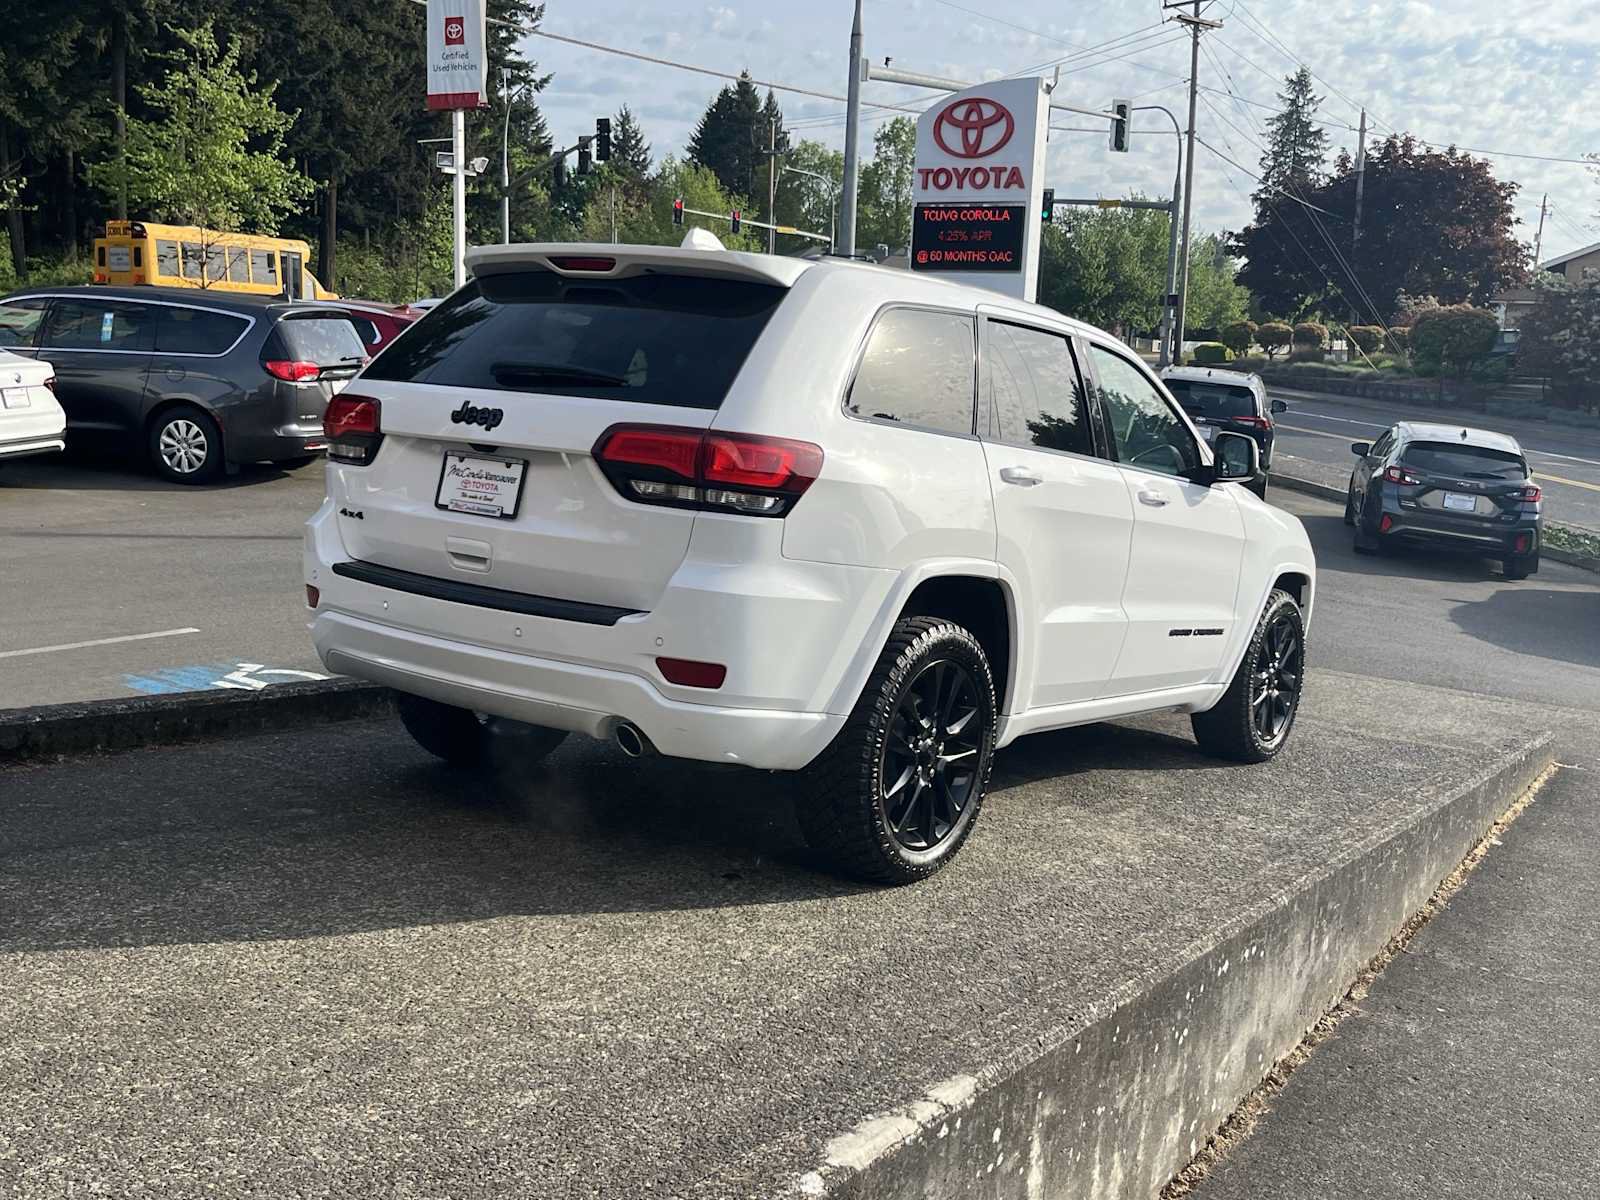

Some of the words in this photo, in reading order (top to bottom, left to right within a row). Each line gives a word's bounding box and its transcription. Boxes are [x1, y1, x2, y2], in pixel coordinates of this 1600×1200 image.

[441, 50, 470, 60] Certified
[432, 64, 450, 72] Used
[450, 62, 478, 71] Vehicles
[917, 166, 1025, 191] TOYOTA
[960, 209, 1010, 221] COROLLA
[916, 250, 929, 264] @
[930, 250, 942, 262] 60
[944, 250, 987, 262] MONTHS
[989, 250, 1013, 262] OAC
[451, 400, 504, 432] Jeep
[472, 480, 499, 491] TOYOTA
